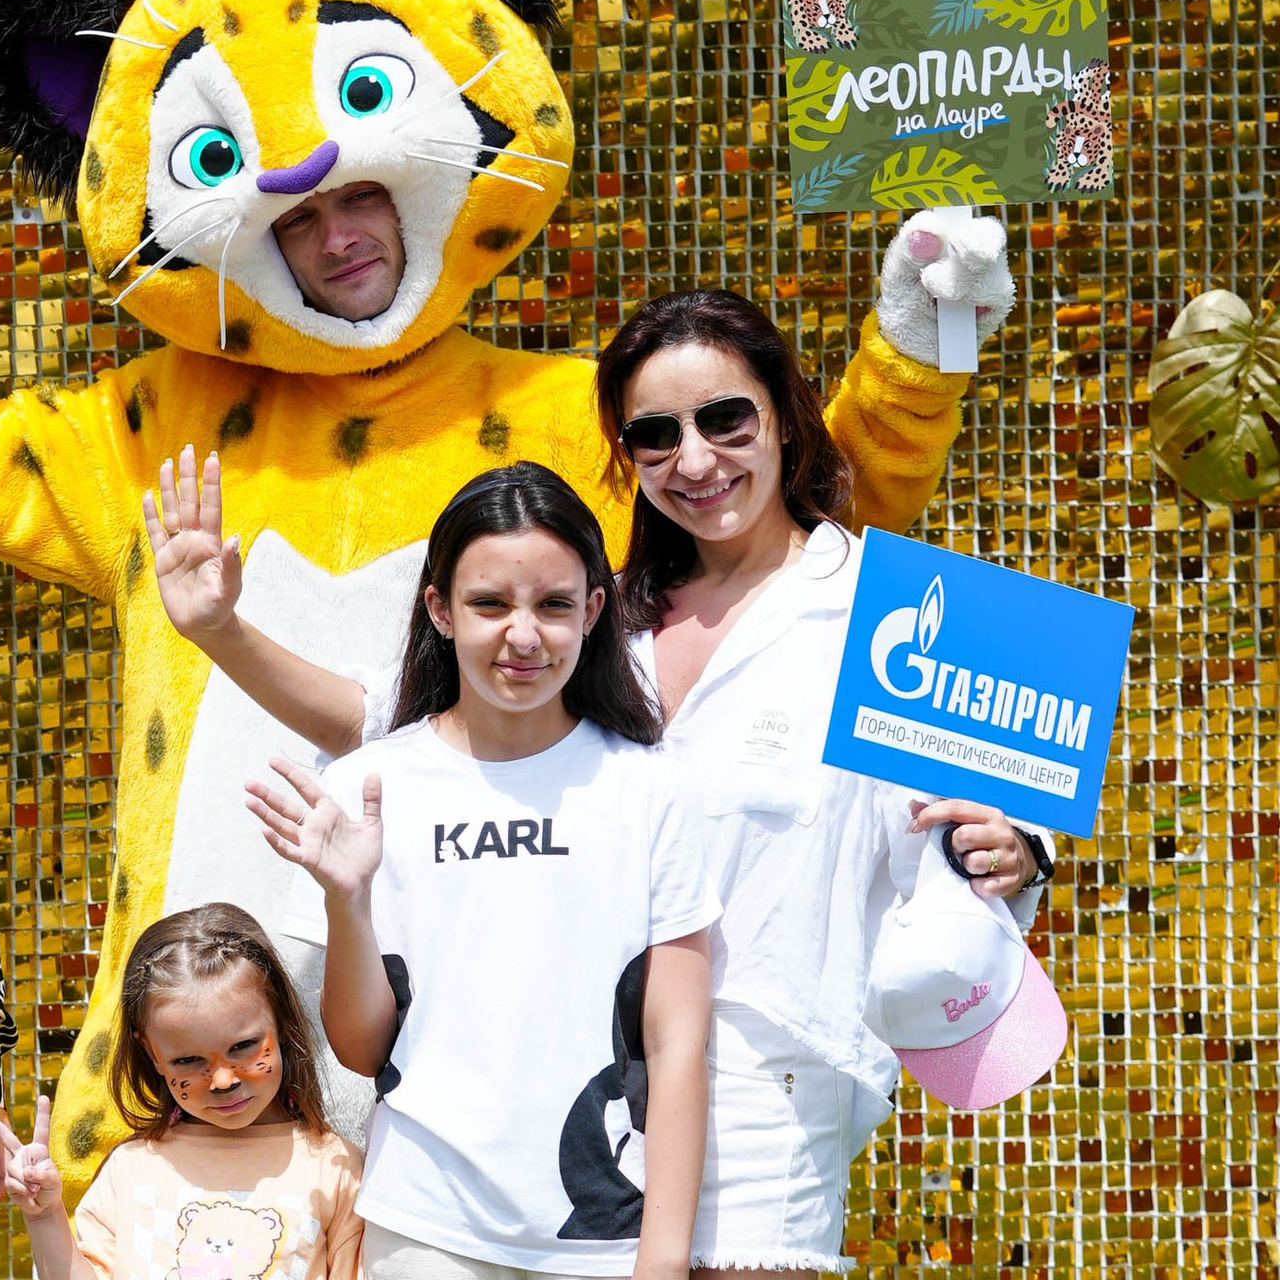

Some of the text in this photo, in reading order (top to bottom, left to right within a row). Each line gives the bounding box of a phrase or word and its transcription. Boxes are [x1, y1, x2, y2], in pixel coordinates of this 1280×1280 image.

[895, 102, 1007, 139] на Лауре
[931, 662, 1093, 752] ГАЗПРОМ
[859, 715, 1074, 790] ГОРНО-ТУРИСТИЧЕСКИЙ ЦЕНТР
[434, 817, 570, 863] KARL
